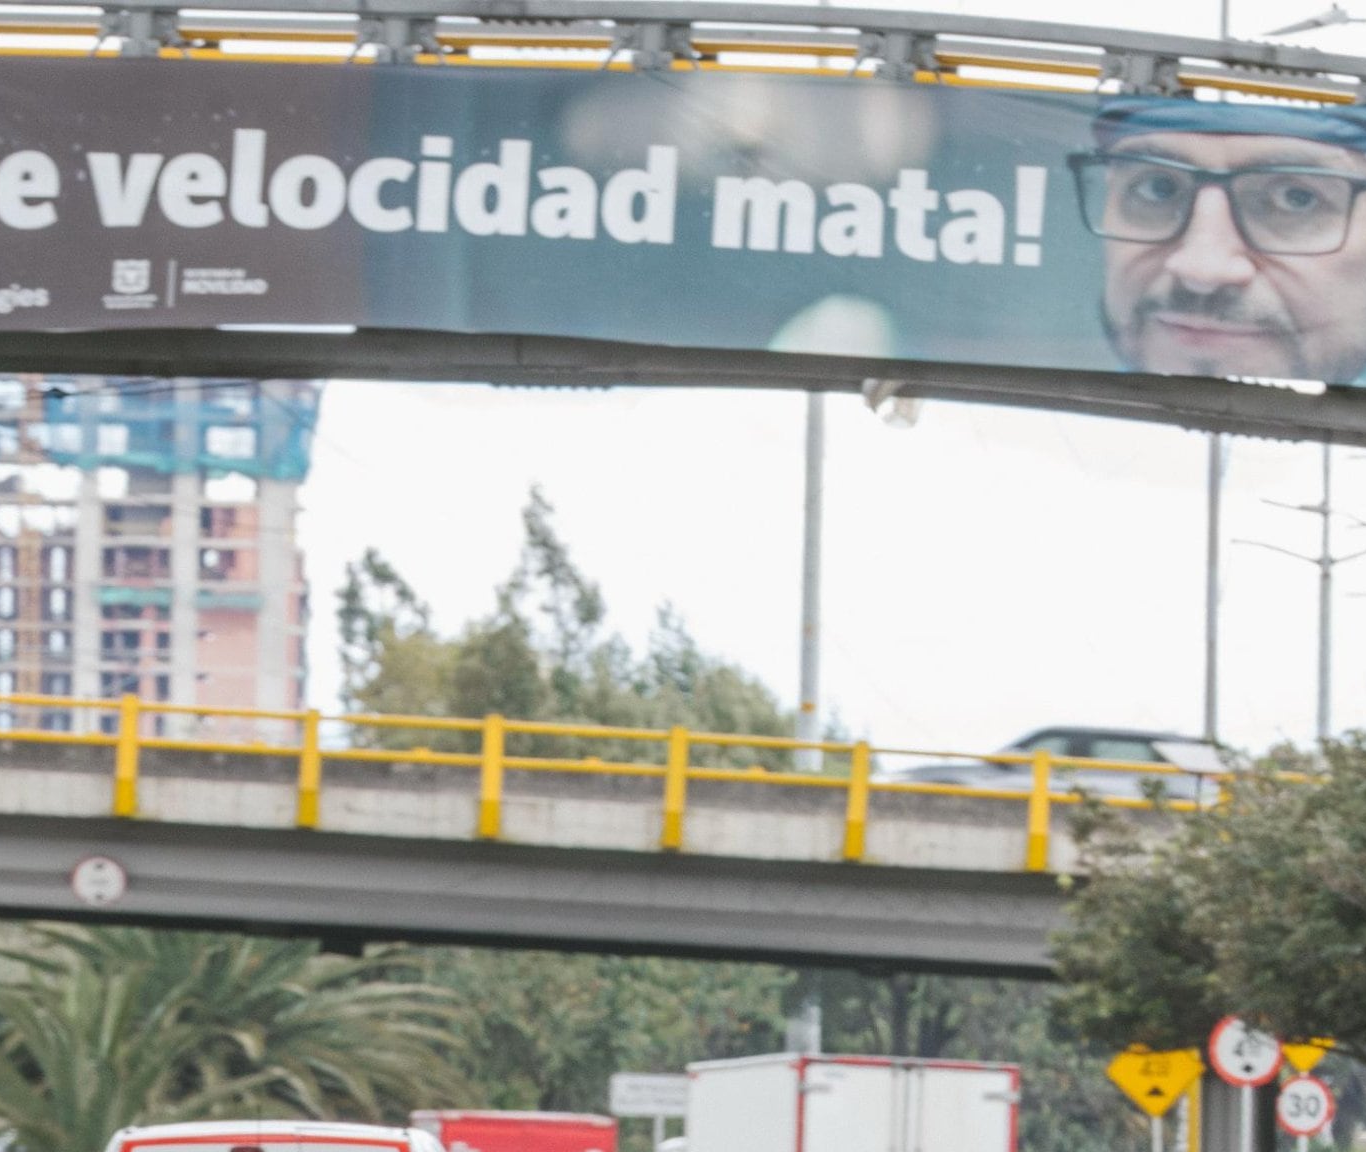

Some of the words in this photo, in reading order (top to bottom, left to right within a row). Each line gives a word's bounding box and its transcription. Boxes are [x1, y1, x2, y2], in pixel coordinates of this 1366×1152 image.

[88, 128, 679, 244] velocidad
[712, 165, 1046, 267] mata!
[1288, 1094, 1320, 1118] 30
